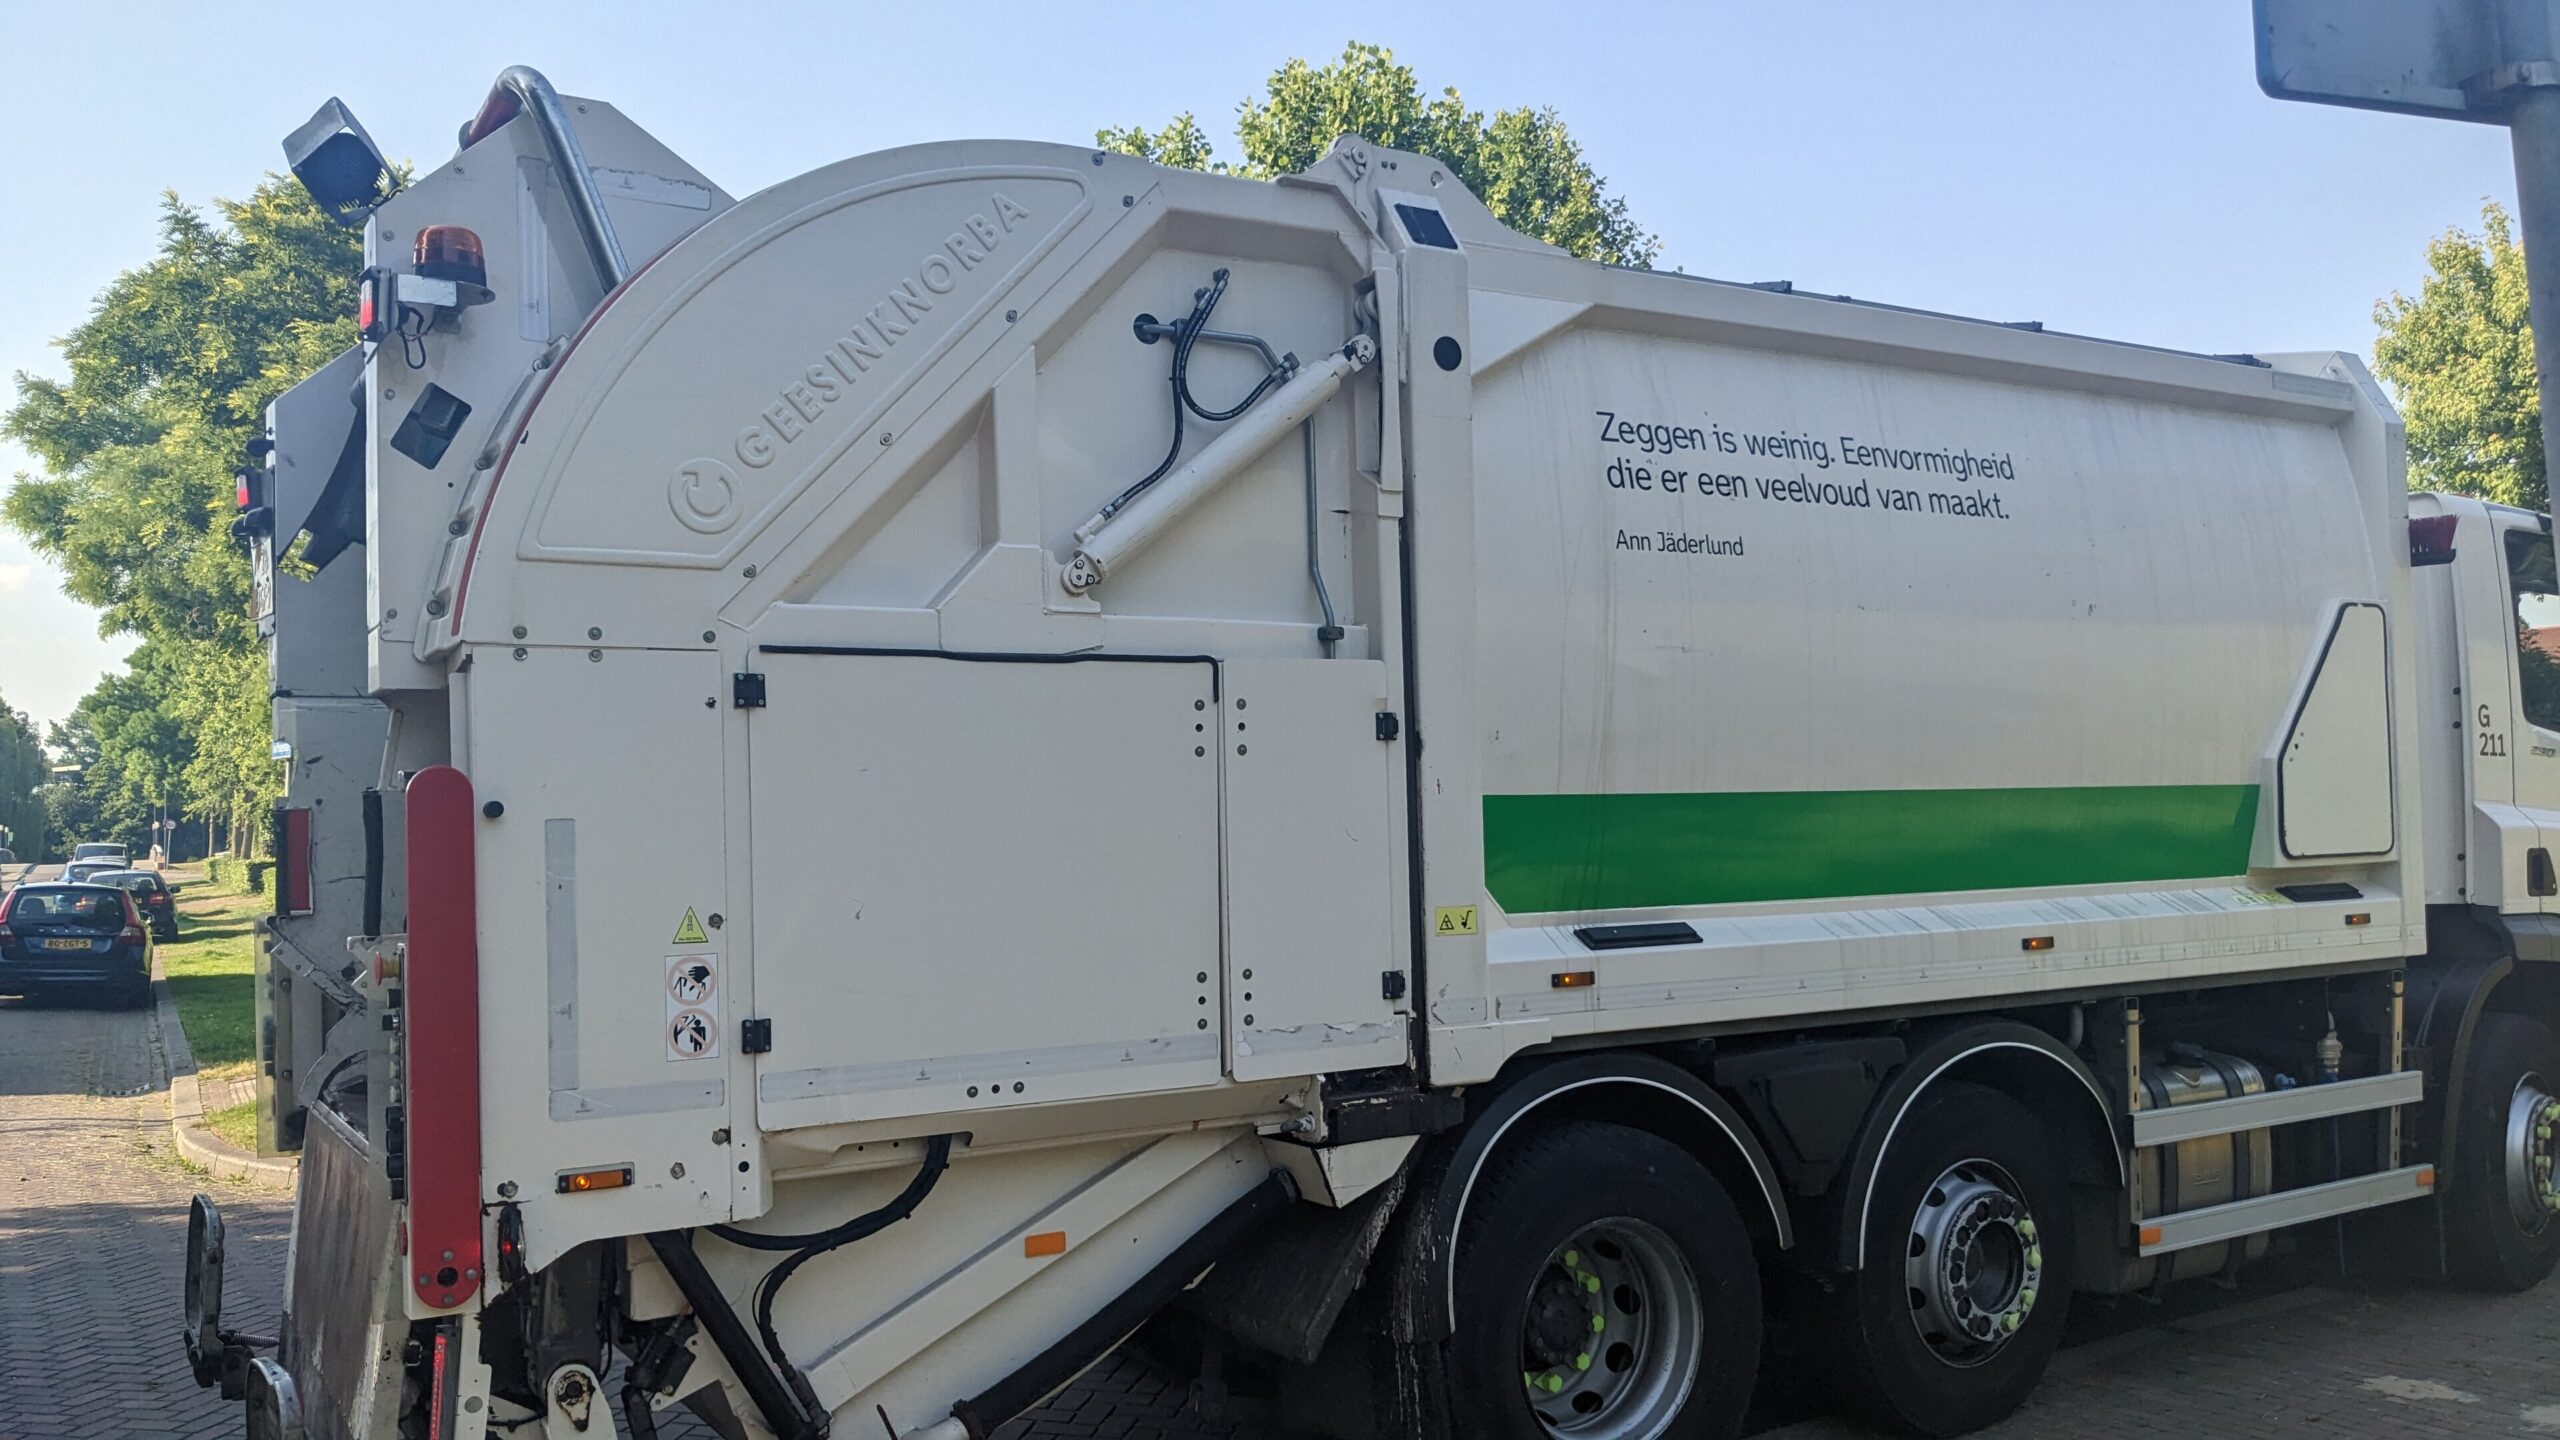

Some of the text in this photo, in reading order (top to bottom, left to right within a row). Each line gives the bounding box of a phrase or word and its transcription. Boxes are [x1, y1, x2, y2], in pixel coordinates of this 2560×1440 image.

[735, 192, 1030, 468] GEESINKNORBA
[1596, 411, 2015, 482] Zeggen is weinig. Eenvormigheid
[1606, 458, 2011, 519] die er een veelvoud van maakt.
[1615, 529, 1745, 557] Ann Jäderlund
[2478, 704, 2490, 727] G
[2479, 733, 2506, 756] 211
